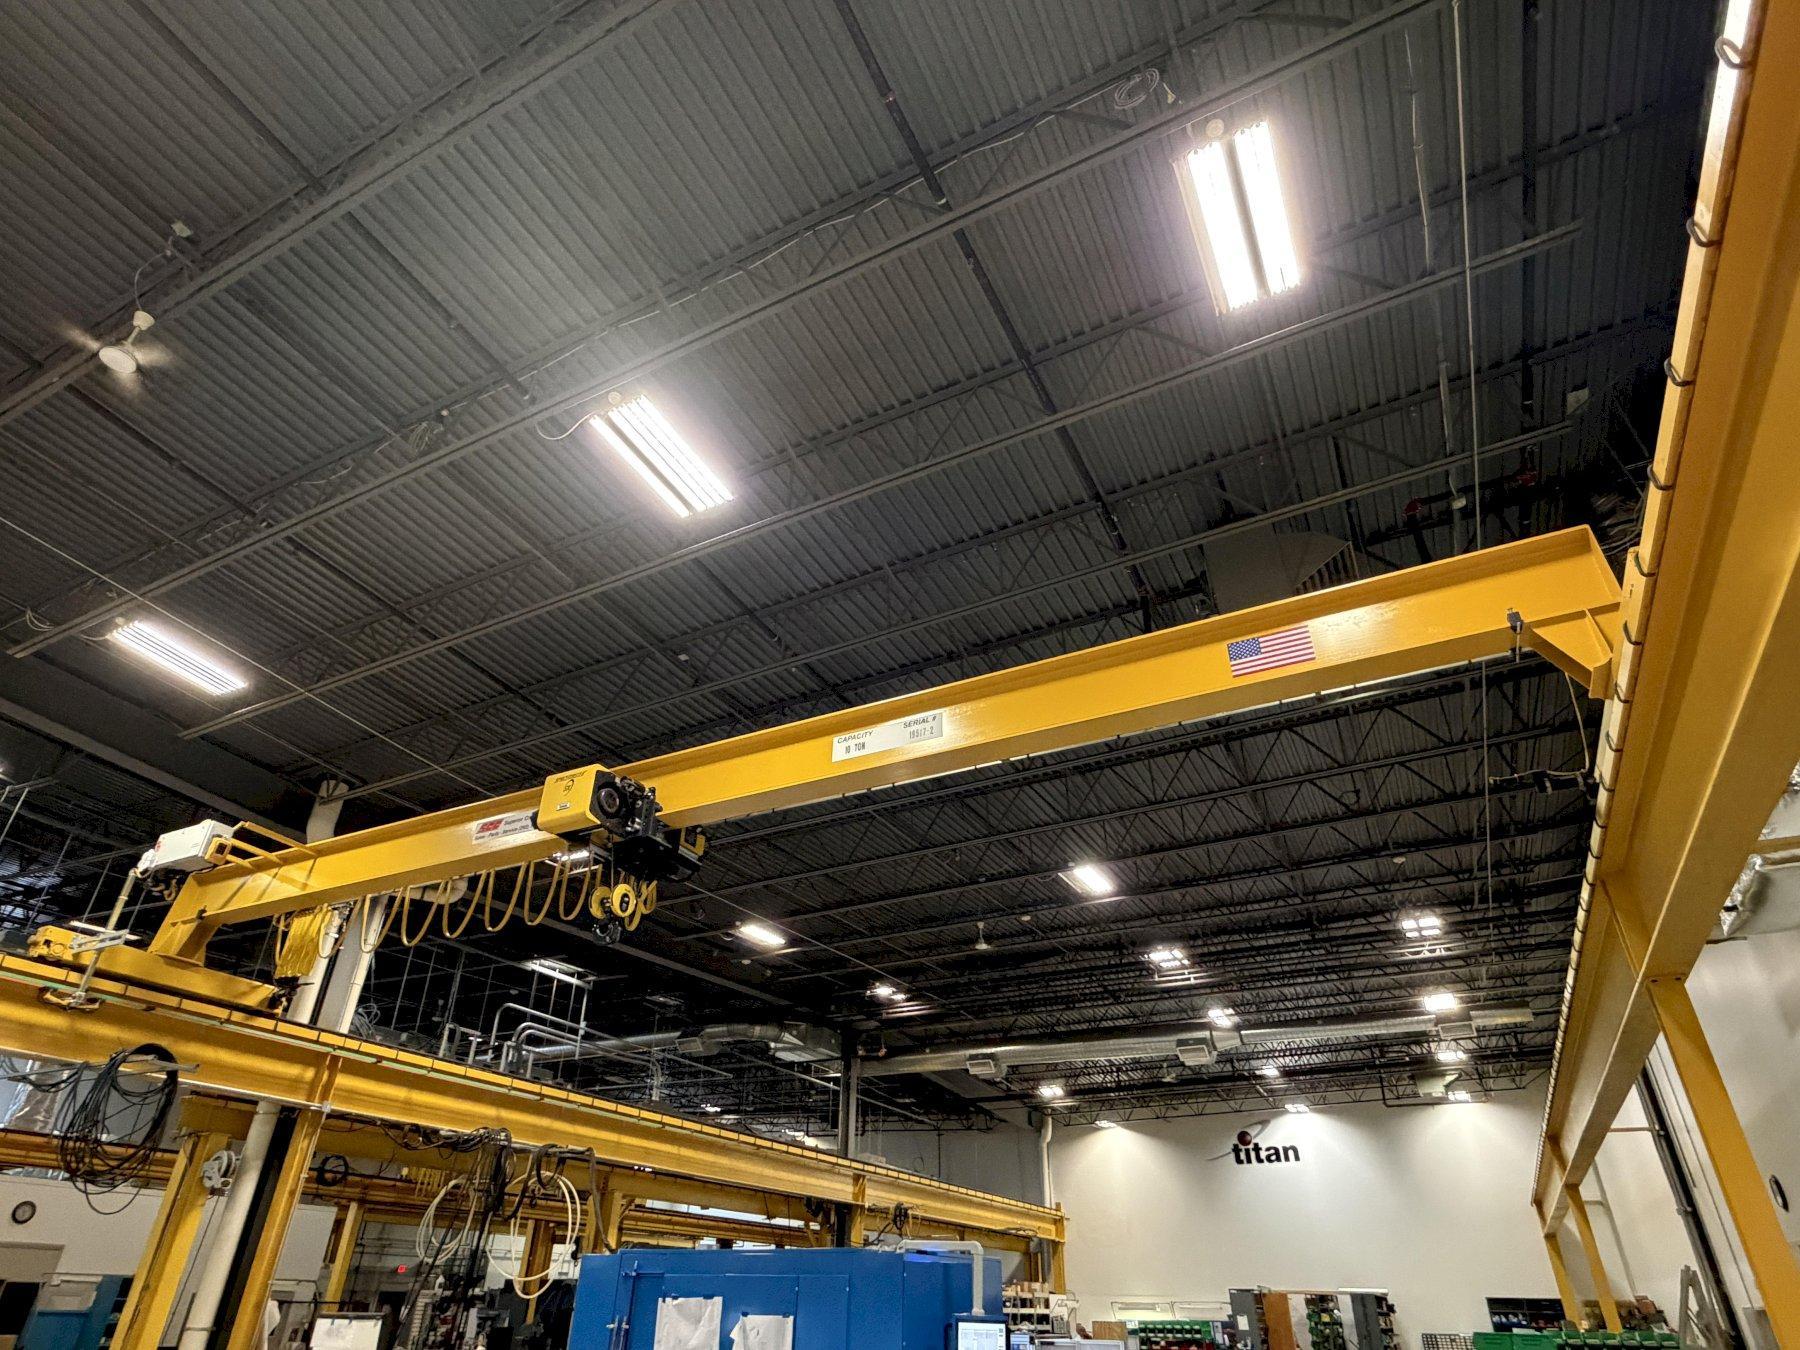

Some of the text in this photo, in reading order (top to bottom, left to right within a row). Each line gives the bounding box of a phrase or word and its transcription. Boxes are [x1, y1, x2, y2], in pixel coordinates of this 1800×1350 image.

[903, 717, 930, 728] SERIAL
[837, 730, 873, 744] CAPACITY
[845, 741, 866, 754] 10 TON
[1232, 1131, 1301, 1164] titan
